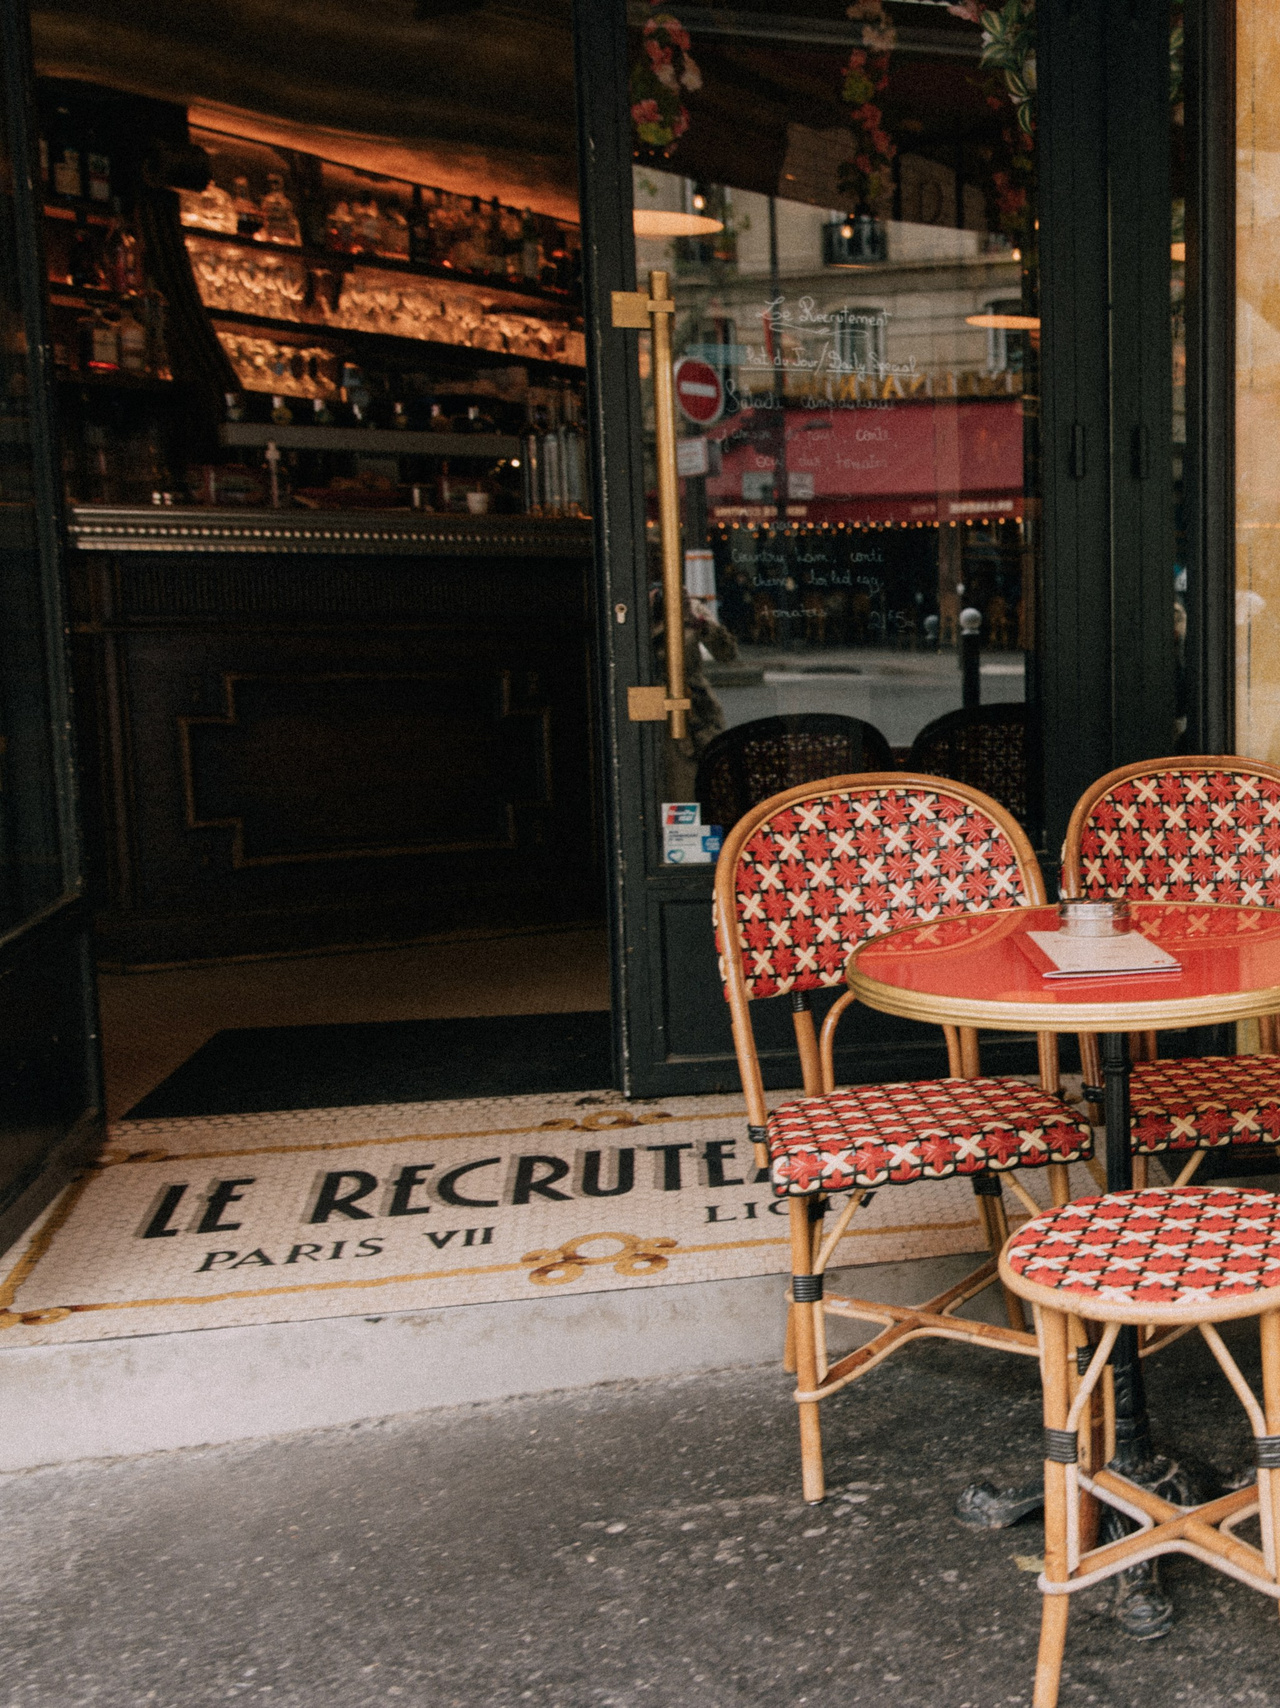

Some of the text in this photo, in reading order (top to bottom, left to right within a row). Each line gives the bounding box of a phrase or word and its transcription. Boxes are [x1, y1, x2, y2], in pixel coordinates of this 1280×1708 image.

[756, 296, 892, 326] Le Recrutement
[136, 1139, 771, 1239] LE RECRUTE
[195, 1226, 493, 1274] PARIS VII
